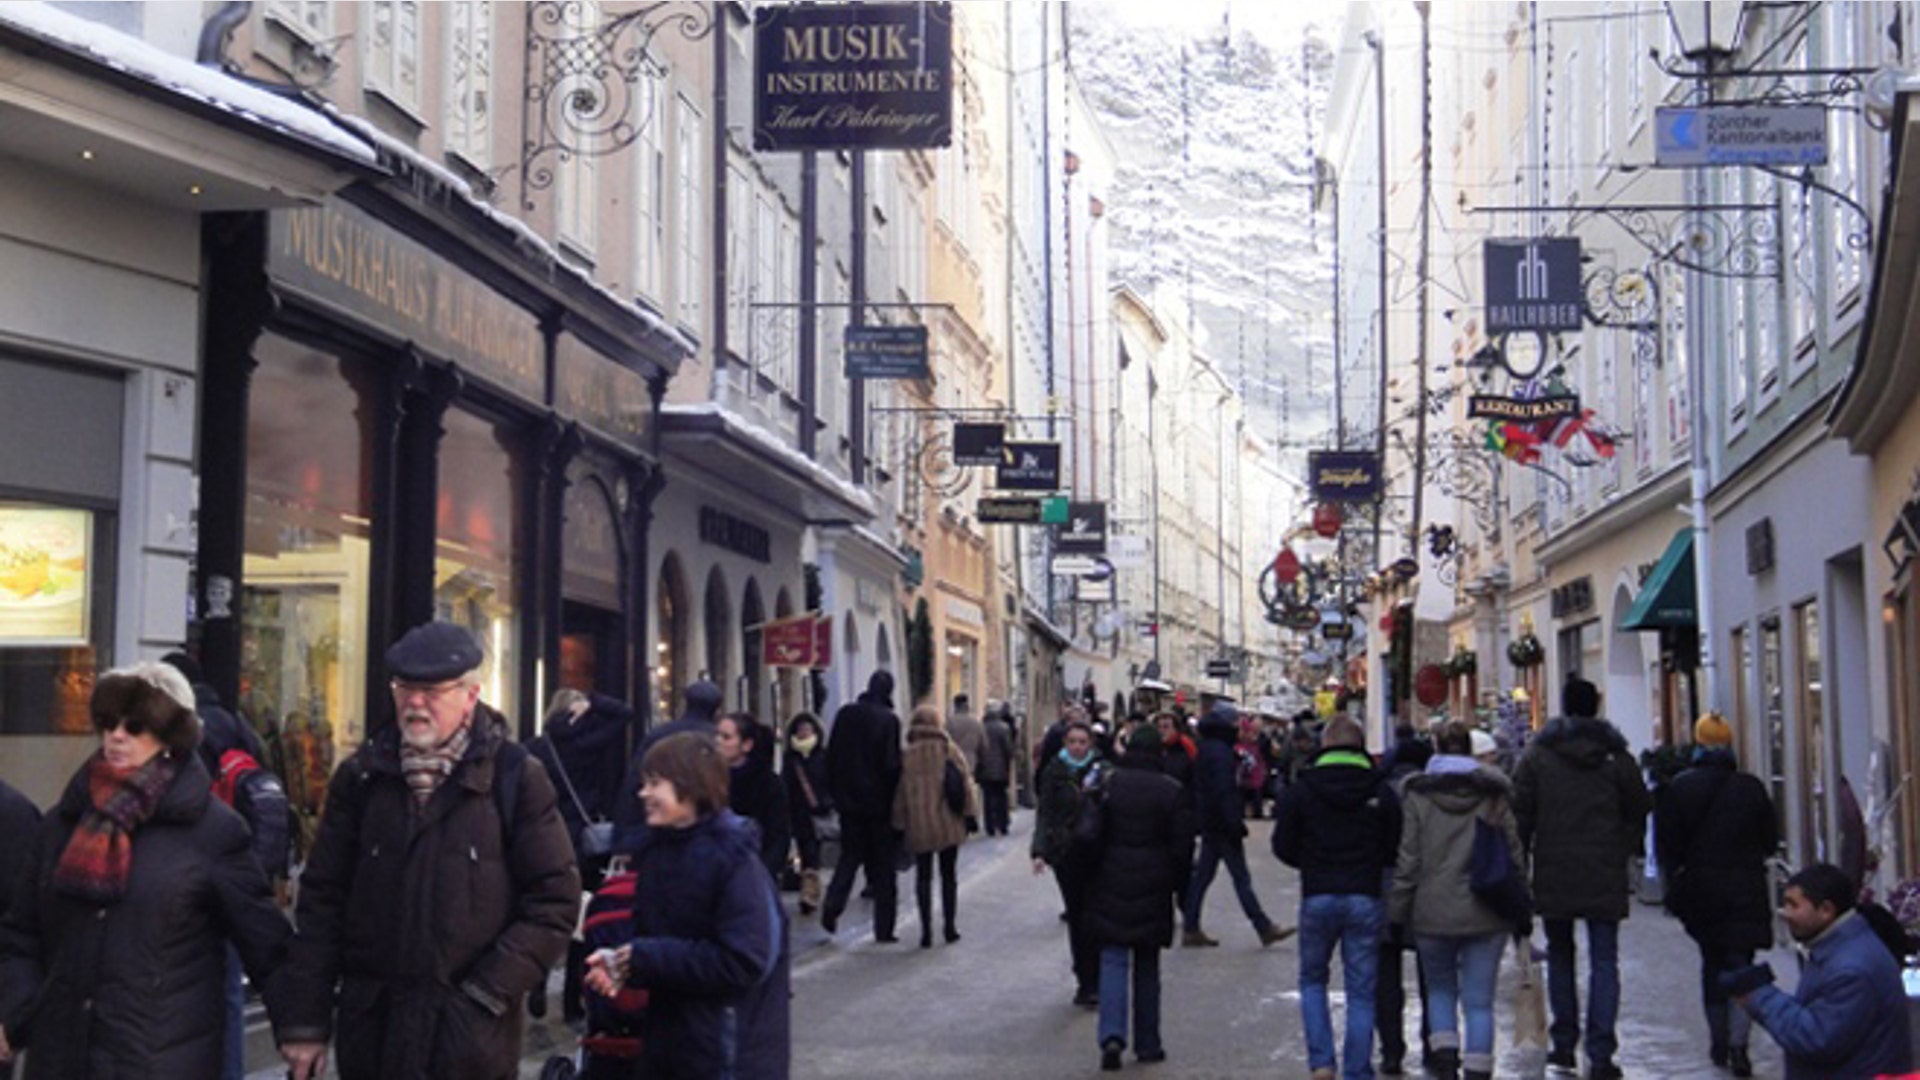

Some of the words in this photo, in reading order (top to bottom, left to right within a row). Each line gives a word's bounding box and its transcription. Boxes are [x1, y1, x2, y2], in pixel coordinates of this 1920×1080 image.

[782, 24, 923, 62] MUSIK-
[767, 69, 941, 95] INSTRUMENTE
[765, 104, 829, 129] Karl
[1706, 114, 1771, 130] Zürcher
[1706, 127, 1823, 145] Kantonalbank
[283, 205, 428, 323] MUSIKHAUS
[1489, 303, 1578, 326] HALLHUBER
[1474, 398, 1576, 418] RESTAURANT
